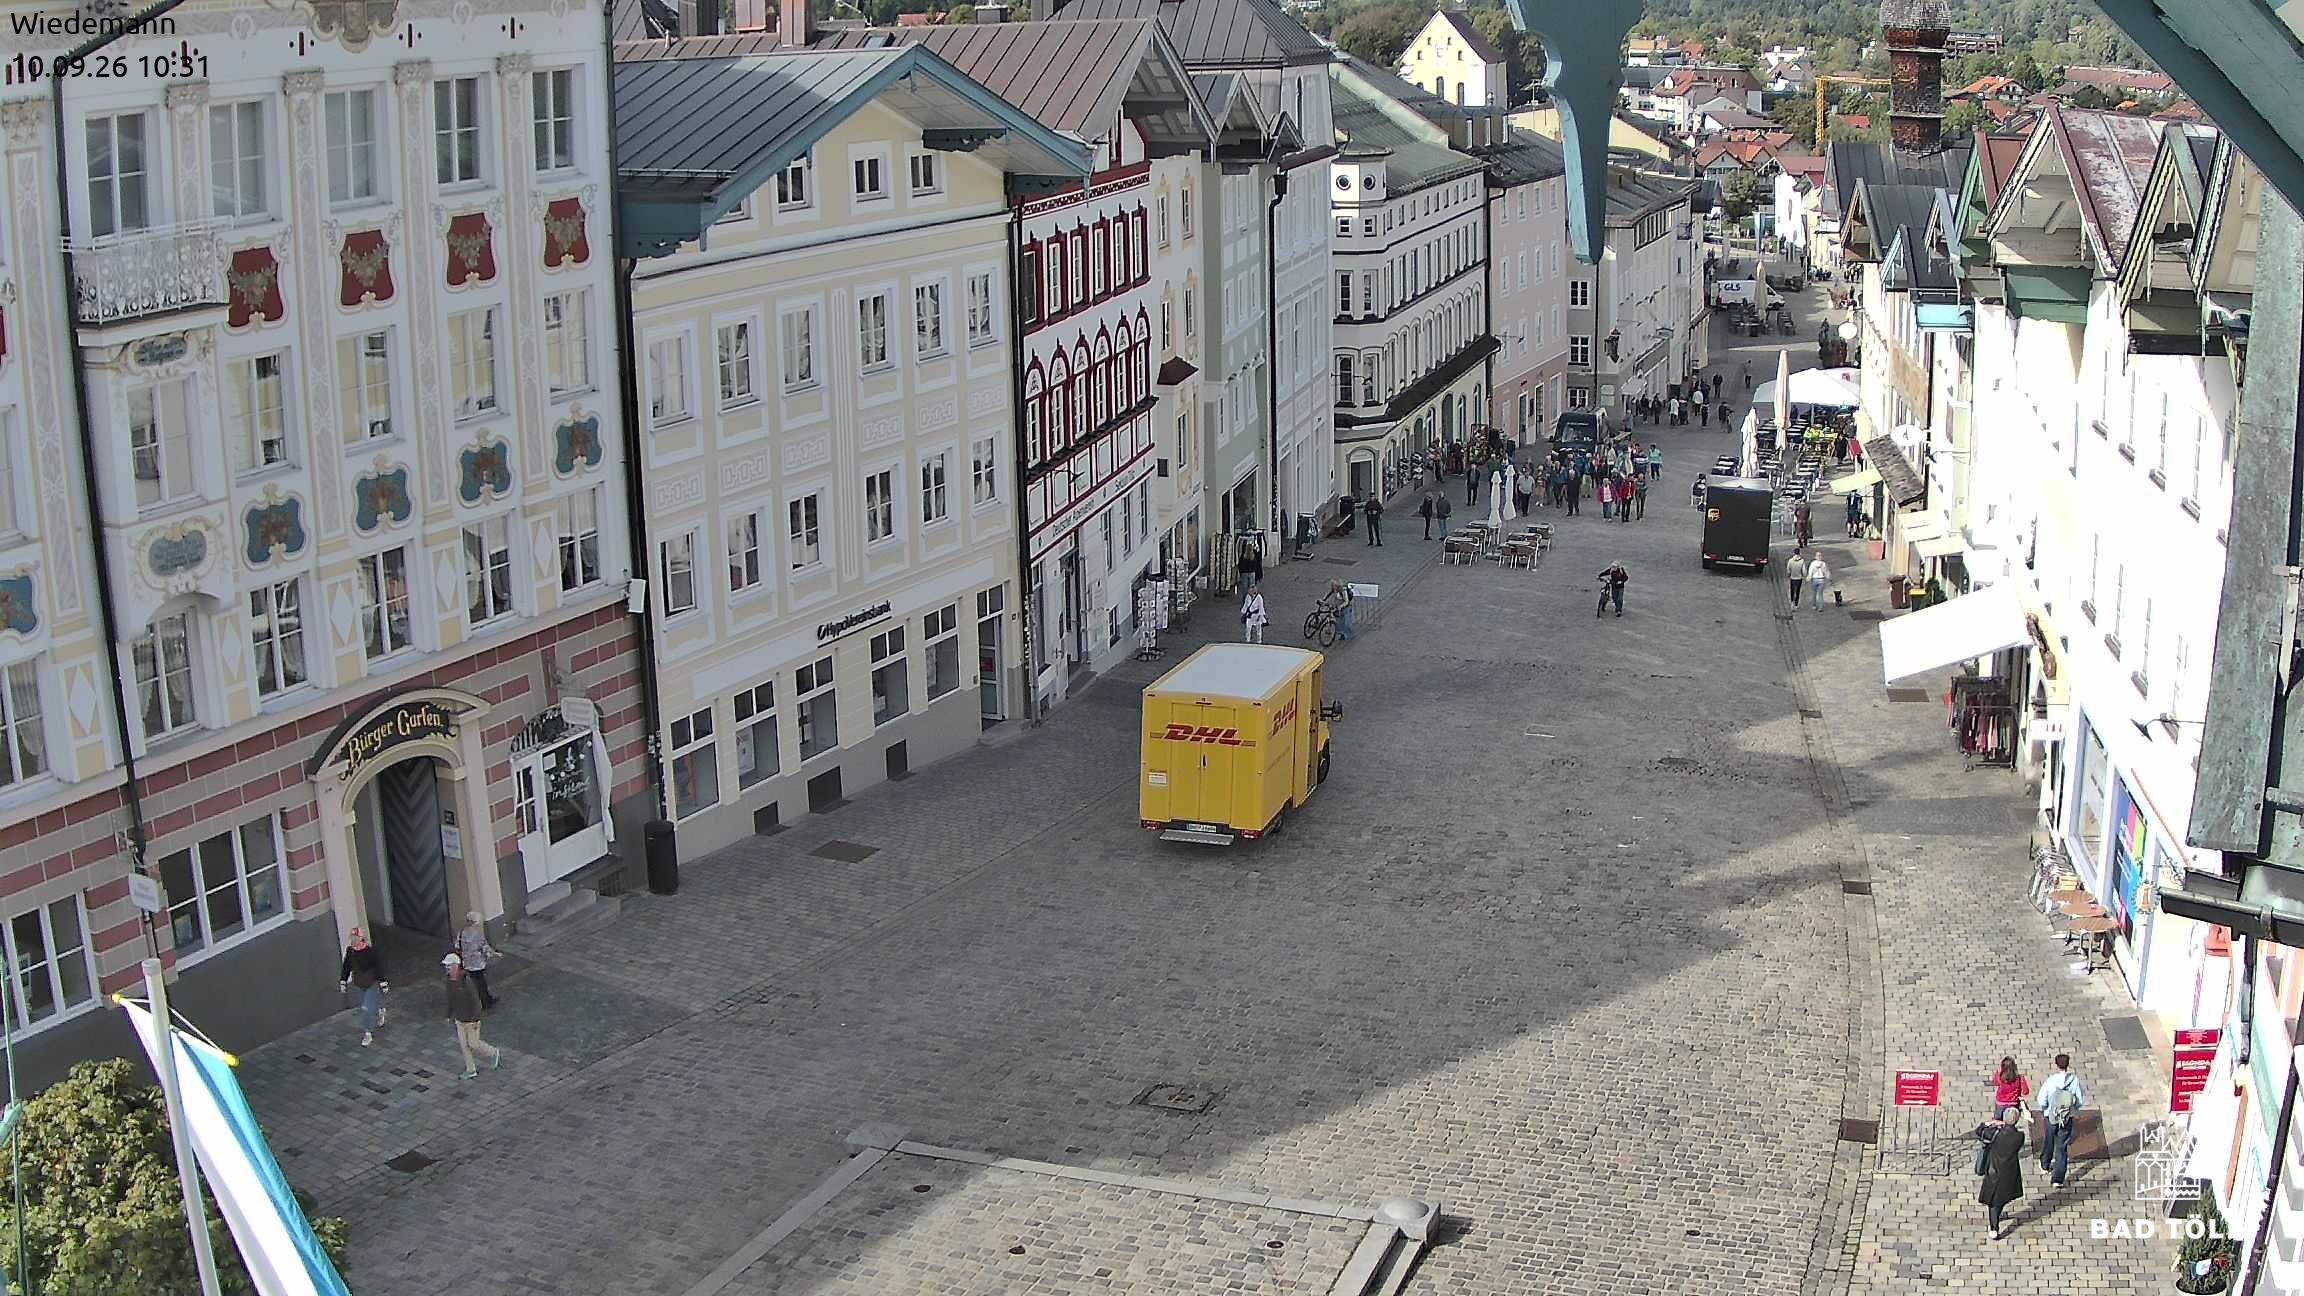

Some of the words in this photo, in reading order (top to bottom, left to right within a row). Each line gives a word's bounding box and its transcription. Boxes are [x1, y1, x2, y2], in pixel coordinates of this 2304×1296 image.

[1724, 283, 1741, 292] GLS
[1272, 698, 1294, 736] DHL
[348, 719, 395, 768] Bürger
[397, 705, 441, 736] Garten
[1164, 723, 1242, 746] DHL
